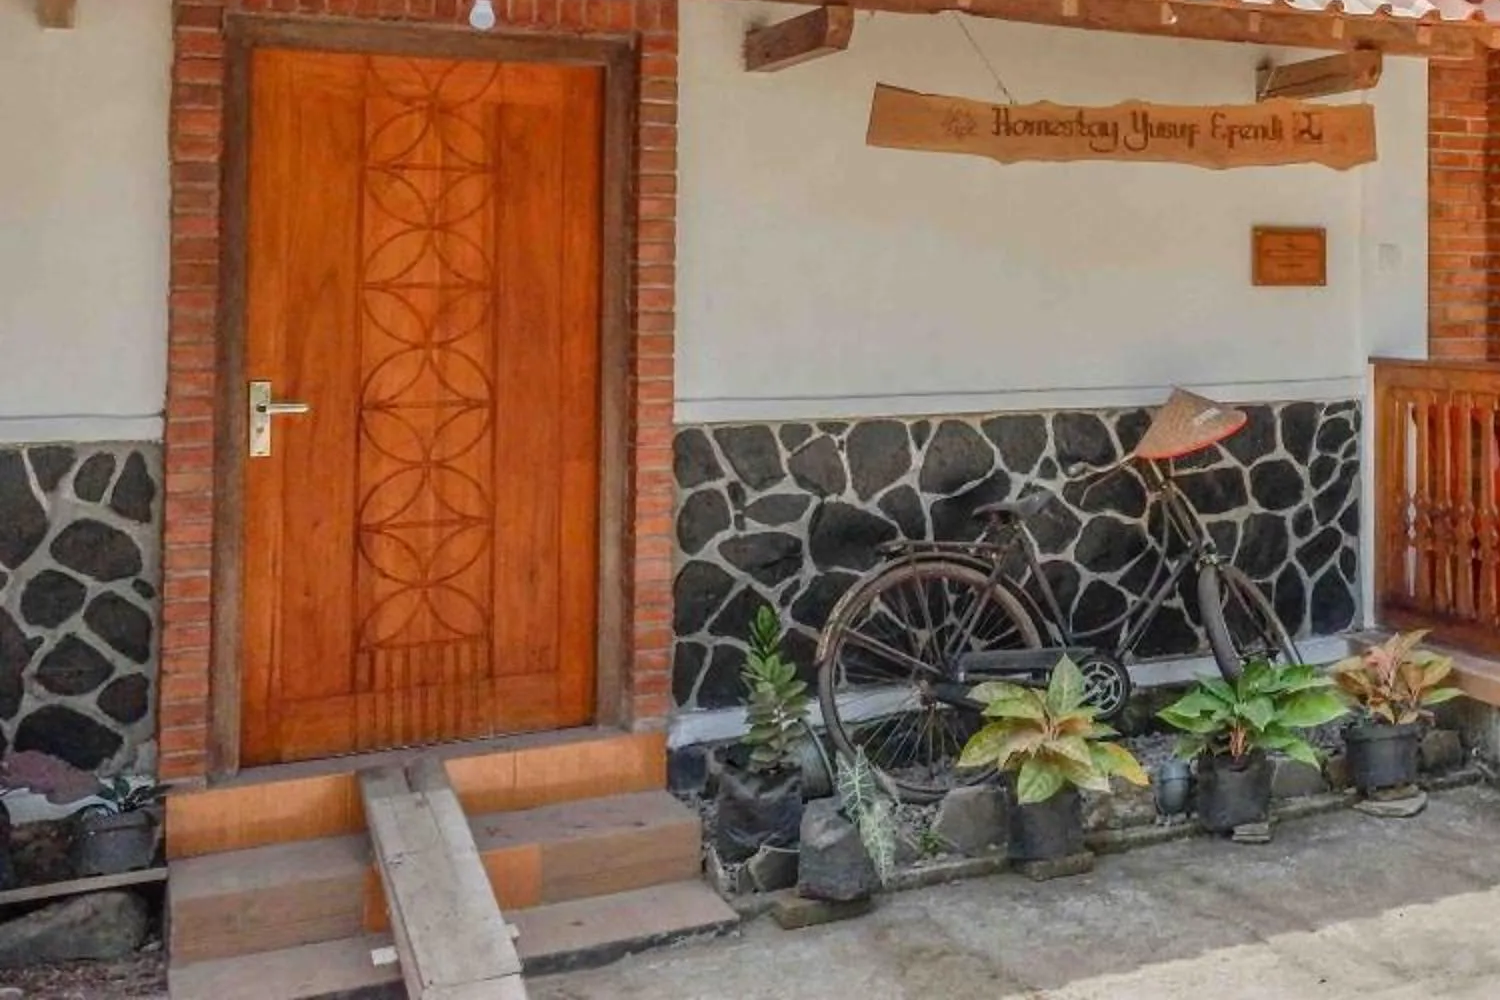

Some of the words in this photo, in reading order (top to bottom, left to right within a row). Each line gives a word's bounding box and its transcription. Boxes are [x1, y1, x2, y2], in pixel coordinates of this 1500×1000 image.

[992, 107, 1119, 152] Homestay
[1123, 109, 1200, 151] Yusuf
[1211, 111, 1283, 149] Efendi
